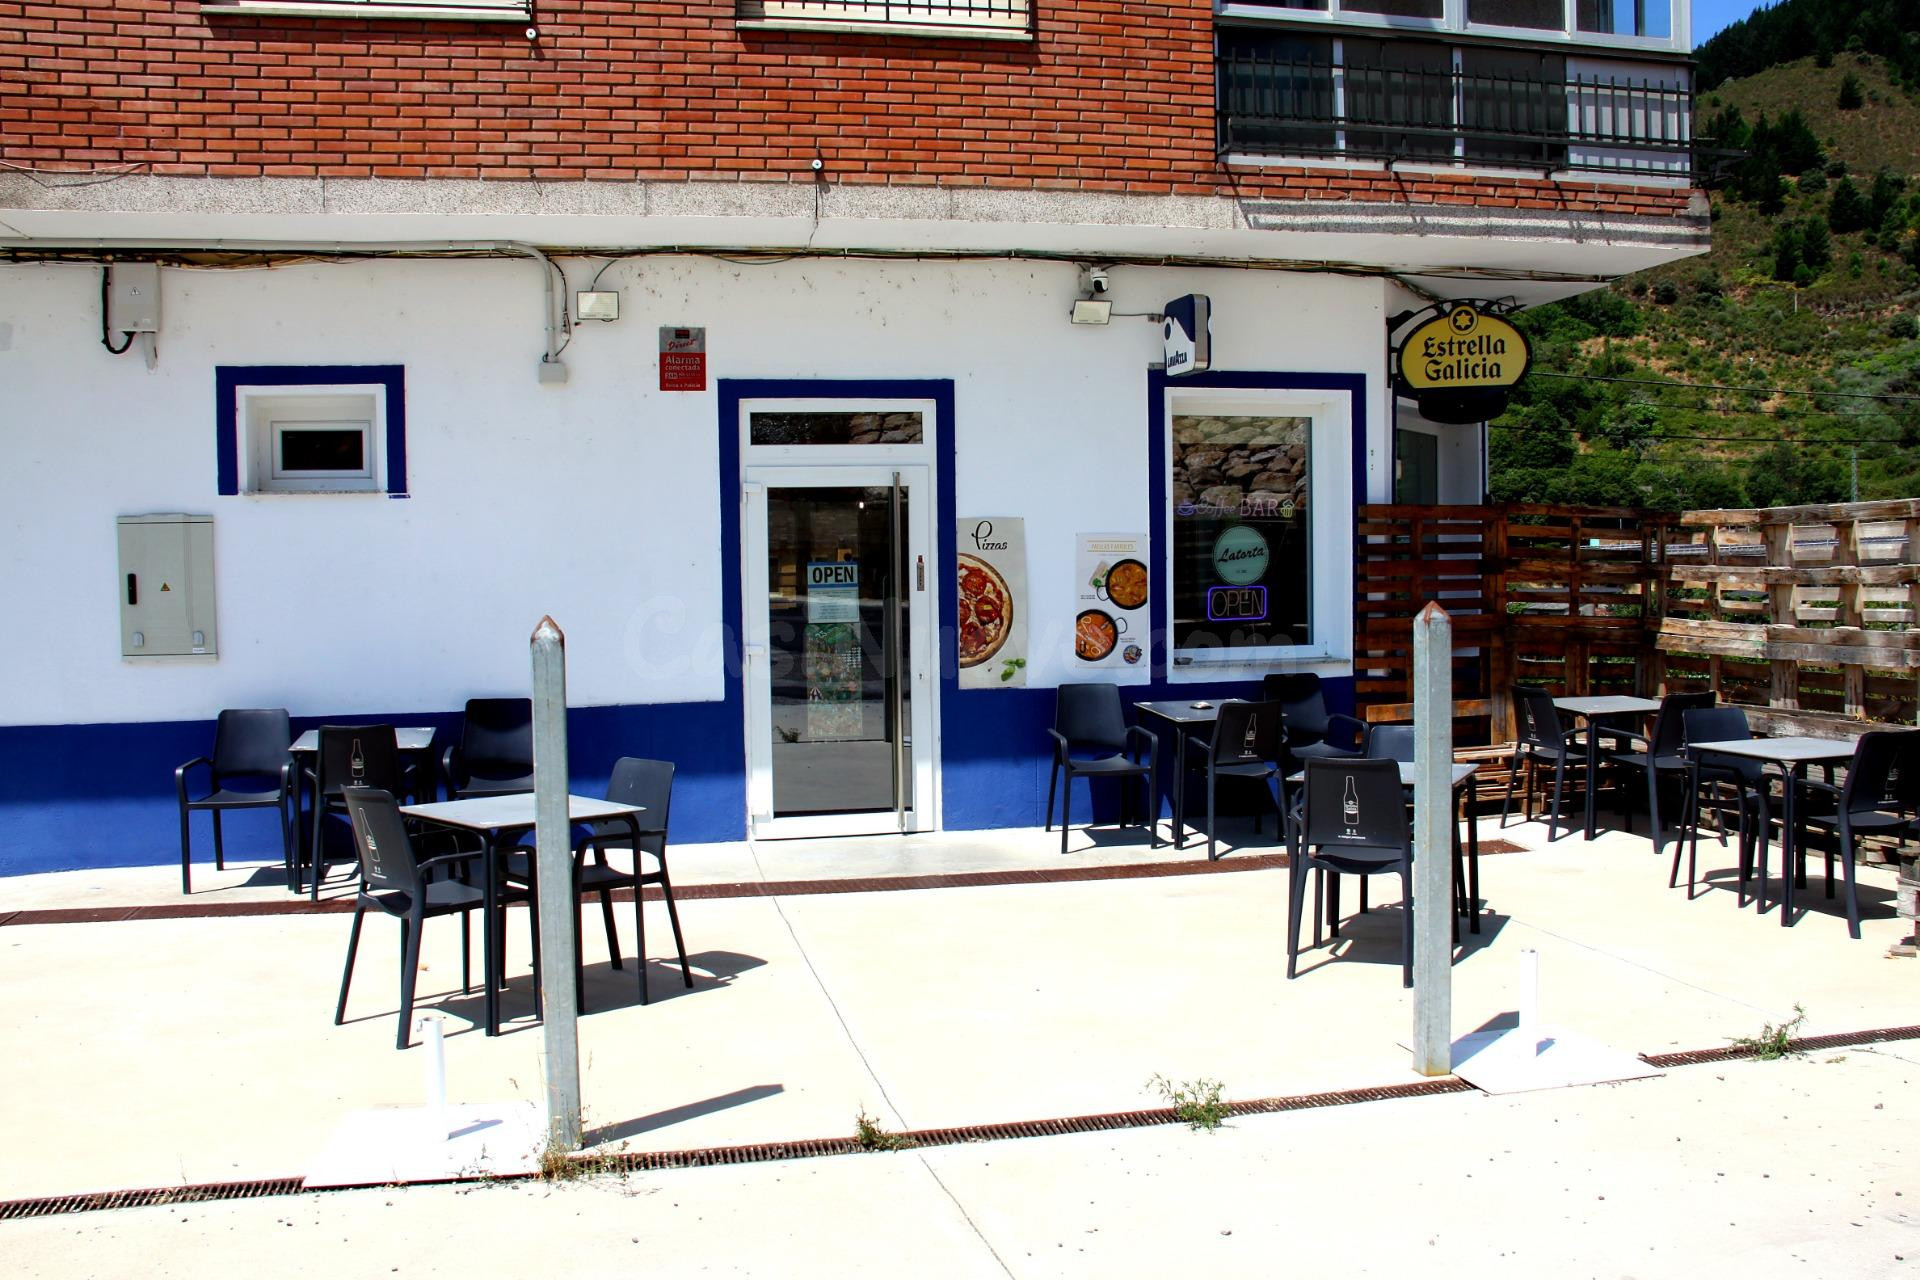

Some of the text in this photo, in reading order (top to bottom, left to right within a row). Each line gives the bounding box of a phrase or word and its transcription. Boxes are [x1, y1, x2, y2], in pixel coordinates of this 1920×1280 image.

[1422, 335, 1506, 358] Estrella
[665, 355, 701, 364] Alarma
[1425, 358, 1503, 381] Galicia
[1240, 498, 1279, 517] BAR
[971, 520, 1008, 550] Pizzas
[1217, 547, 1265, 563] Latorta
[812, 566, 854, 584] OPEN
[1211, 589, 1264, 617] OPEN
